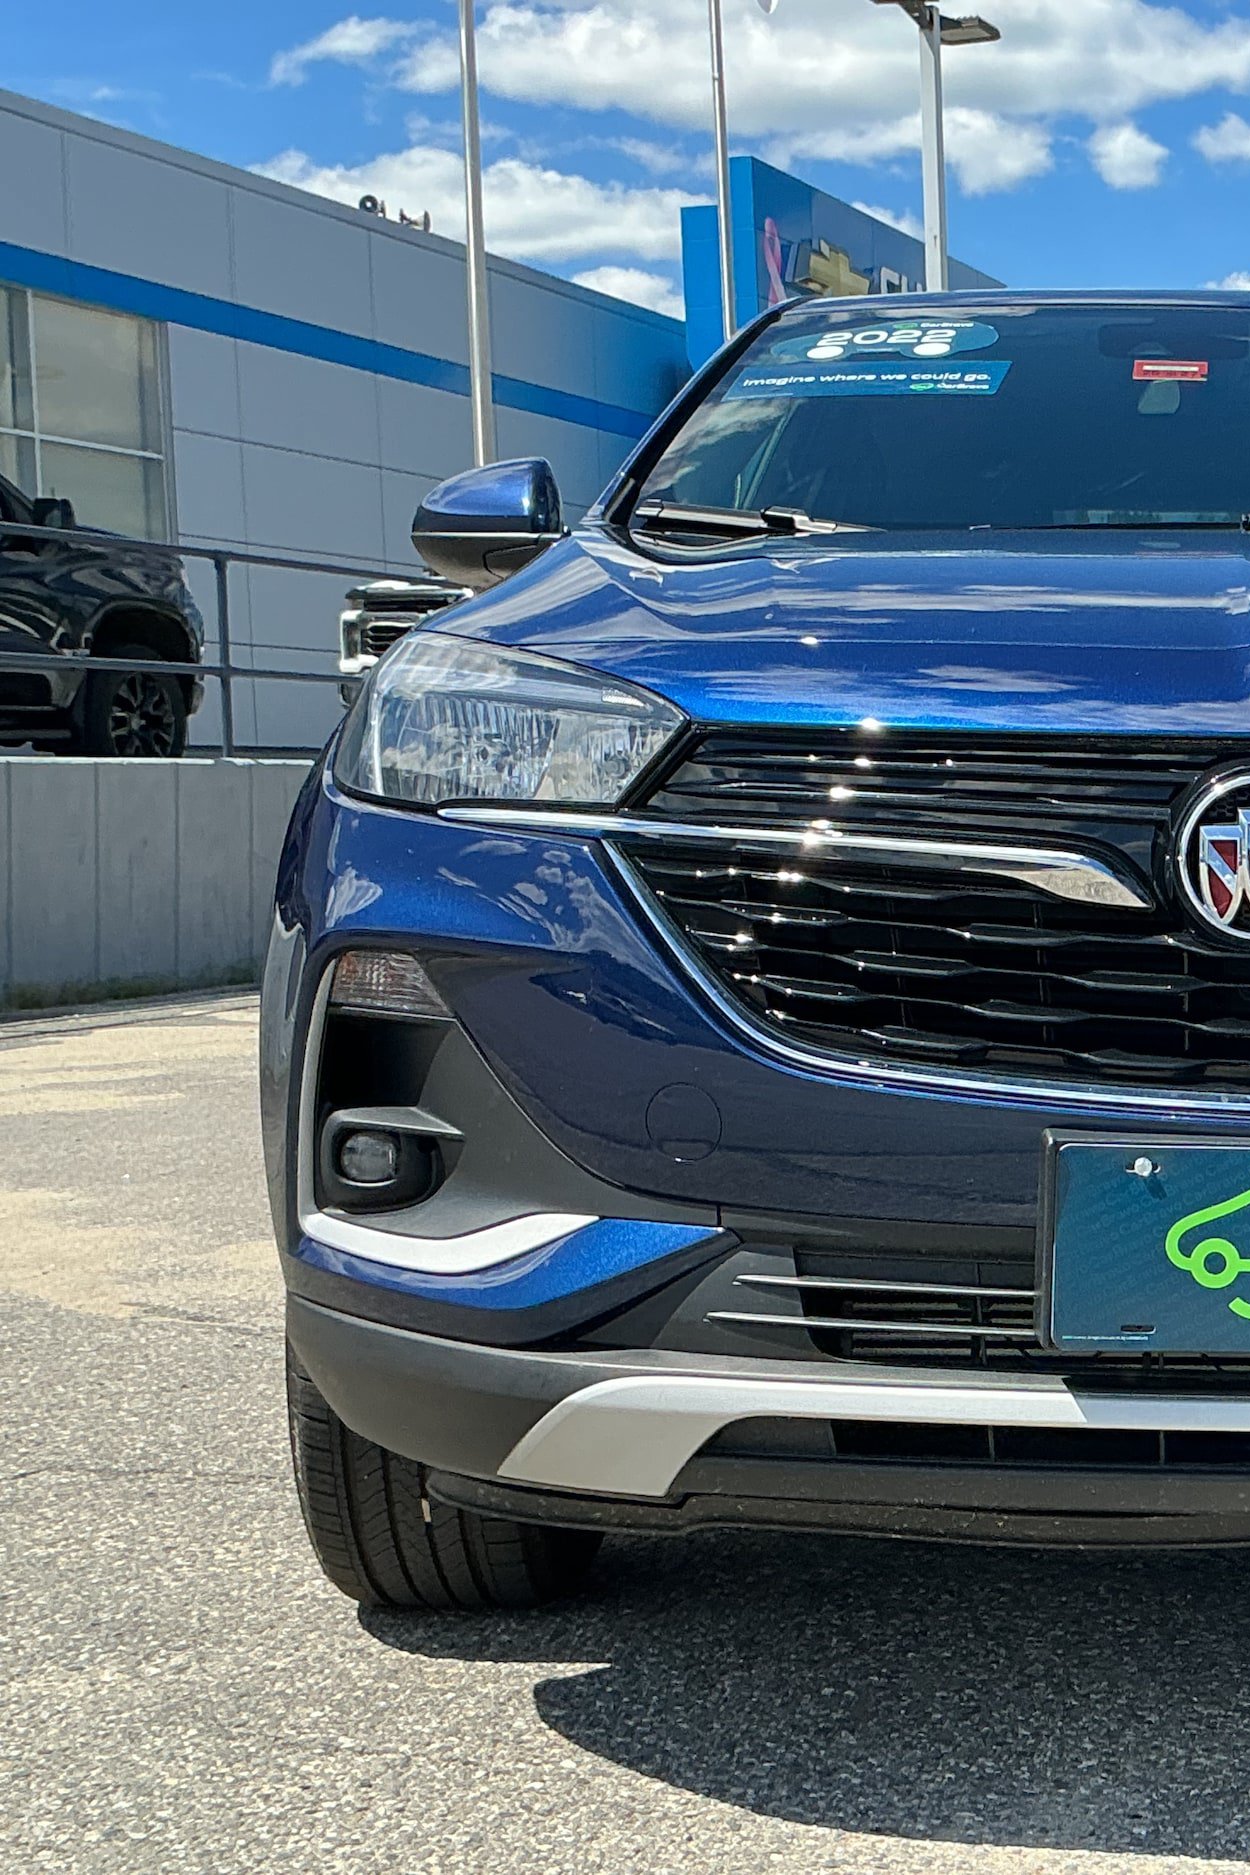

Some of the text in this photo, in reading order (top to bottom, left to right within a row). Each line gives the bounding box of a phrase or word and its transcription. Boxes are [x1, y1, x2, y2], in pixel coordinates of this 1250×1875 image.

[816, 329, 957, 346] 2022
[819, 373, 877, 382] where
[880, 373, 908, 381] we
[910, 372, 962, 381] could
